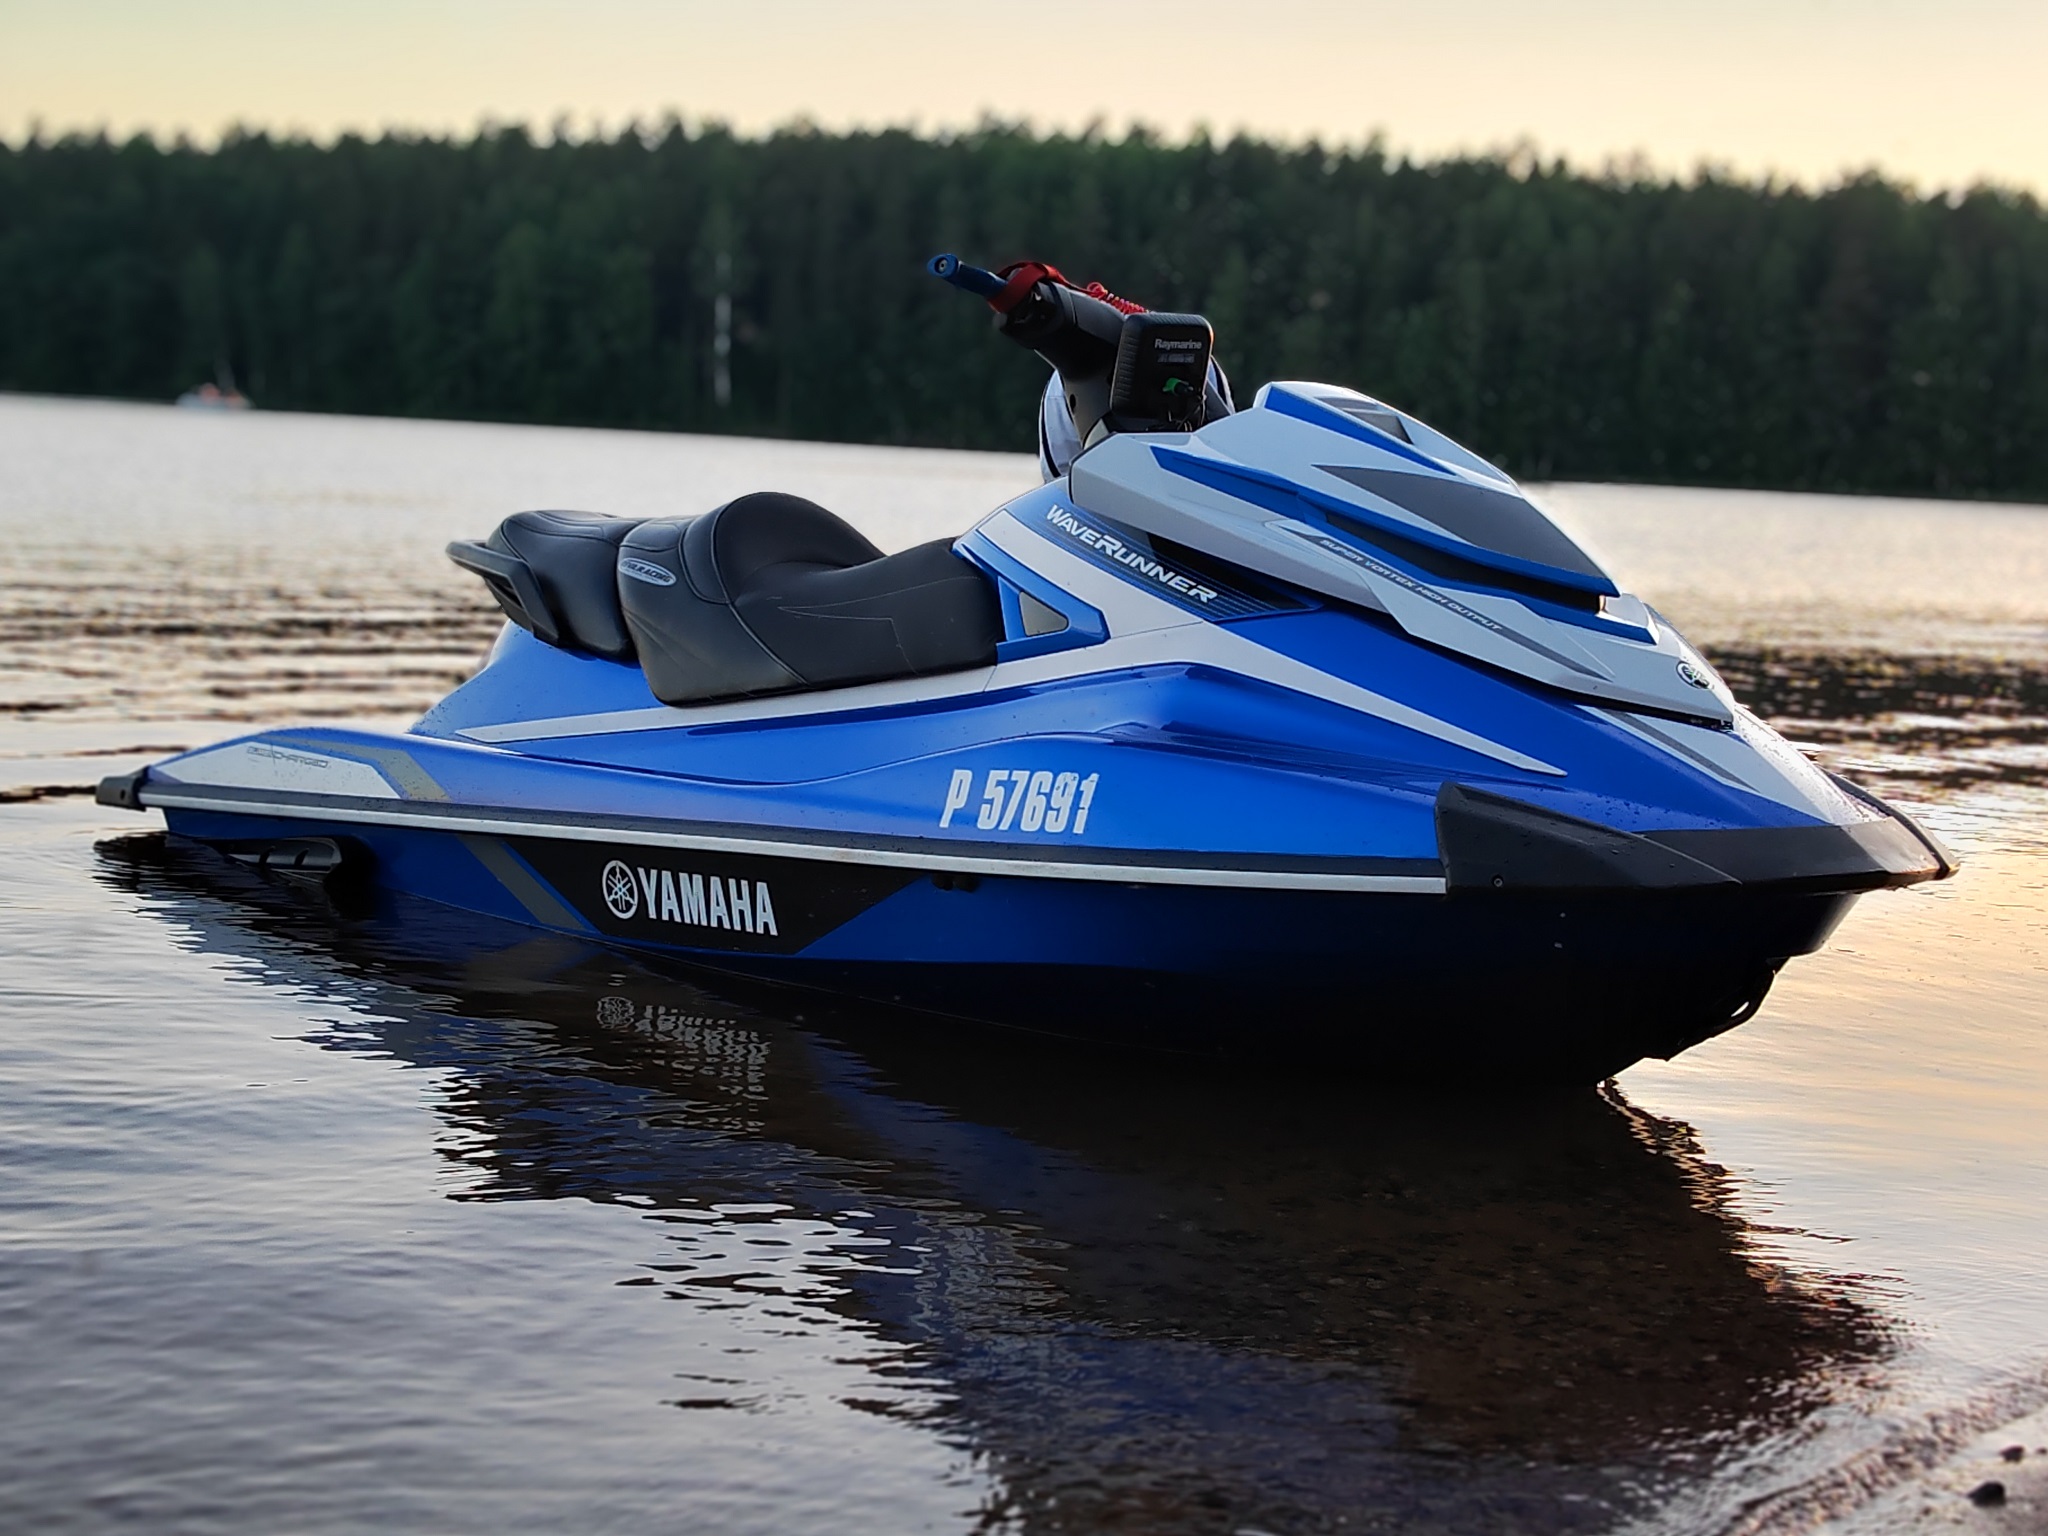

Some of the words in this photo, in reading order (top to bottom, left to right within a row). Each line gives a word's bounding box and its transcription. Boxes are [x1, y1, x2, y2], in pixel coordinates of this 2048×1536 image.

[1154, 338, 1202, 351] Raymarine
[1046, 504, 1218, 603] WAVERUNNER
[1365, 560, 1417, 588] VORTEX
[1415, 586, 1448, 604] HIGH
[1447, 602, 1503, 630] OUTPUT
[939, 769, 973, 828] P
[977, 769, 1100, 834] 57691
[637, 867, 778, 936] YAMAHA
